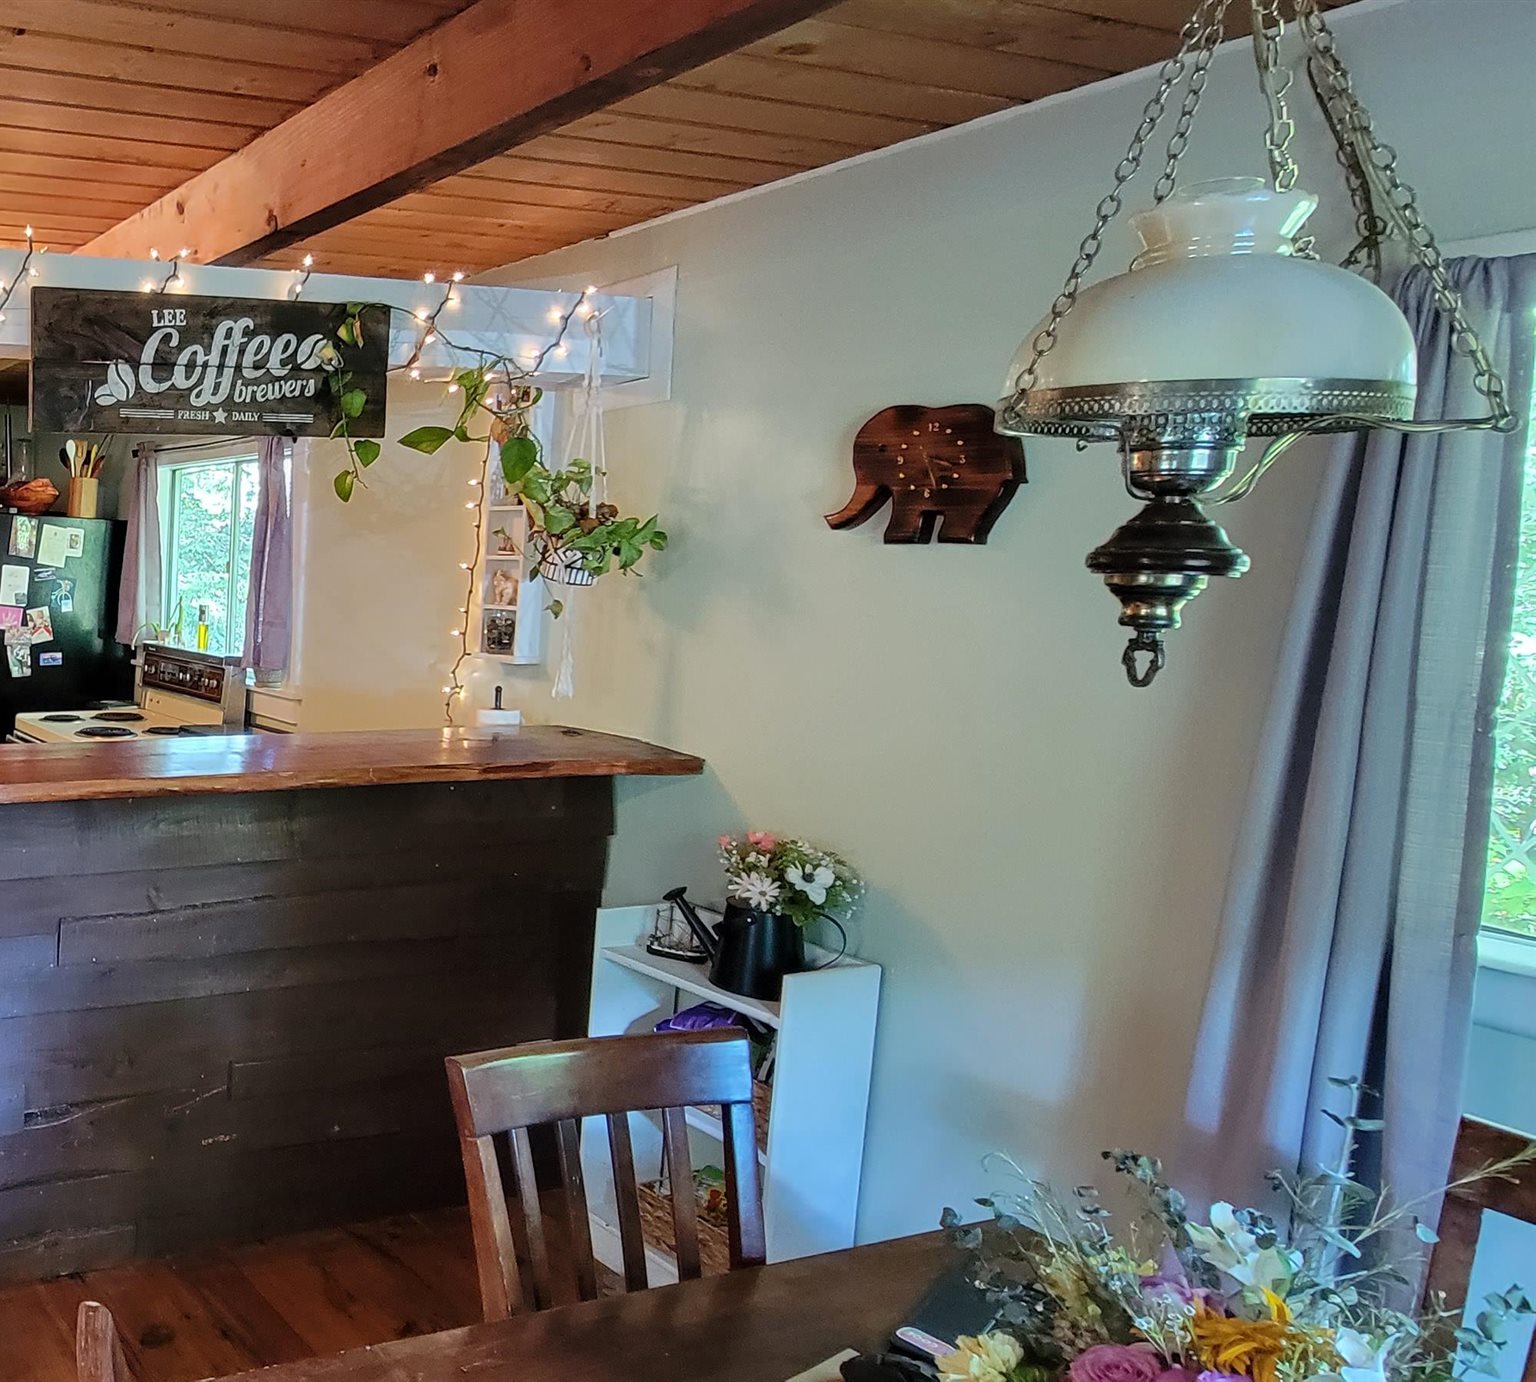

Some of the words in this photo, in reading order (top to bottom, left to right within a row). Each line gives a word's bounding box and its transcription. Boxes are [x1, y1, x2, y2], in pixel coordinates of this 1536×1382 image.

[151, 309, 187, 328] LEE
[138, 317, 298, 407] Coffee
[233, 377, 316, 404] brewers
[177, 409, 210, 422] FRESH
[231, 411, 261, 423] DAILY
